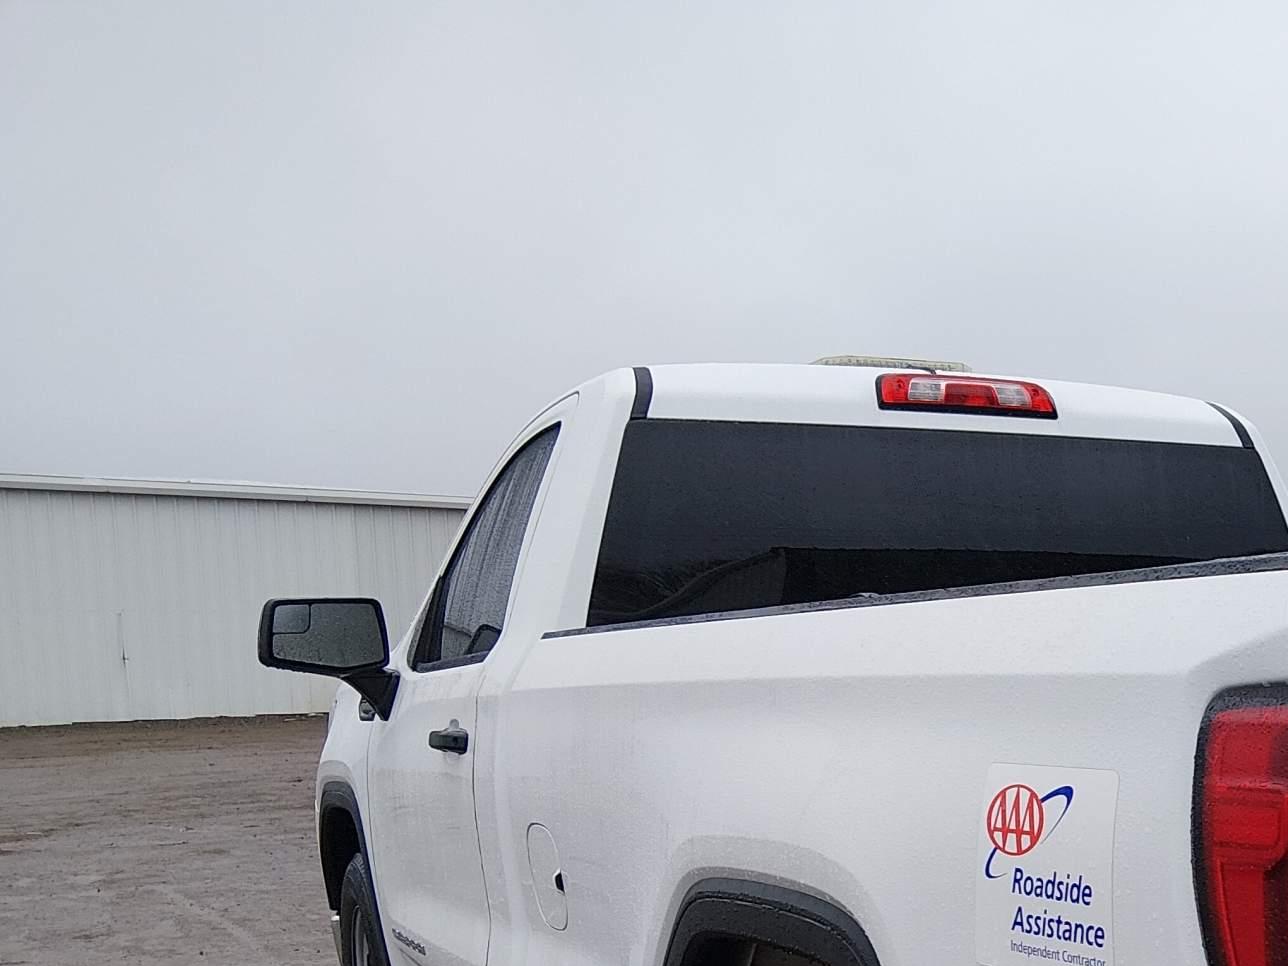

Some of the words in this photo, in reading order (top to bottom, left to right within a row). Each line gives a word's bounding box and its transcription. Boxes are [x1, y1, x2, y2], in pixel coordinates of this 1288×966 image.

[990, 784, 1040, 854] AAA
[1011, 867, 1093, 905] Roadside
[1011, 906, 1105, 948] Assistance
[1010, 939, 1061, 961] Independent
